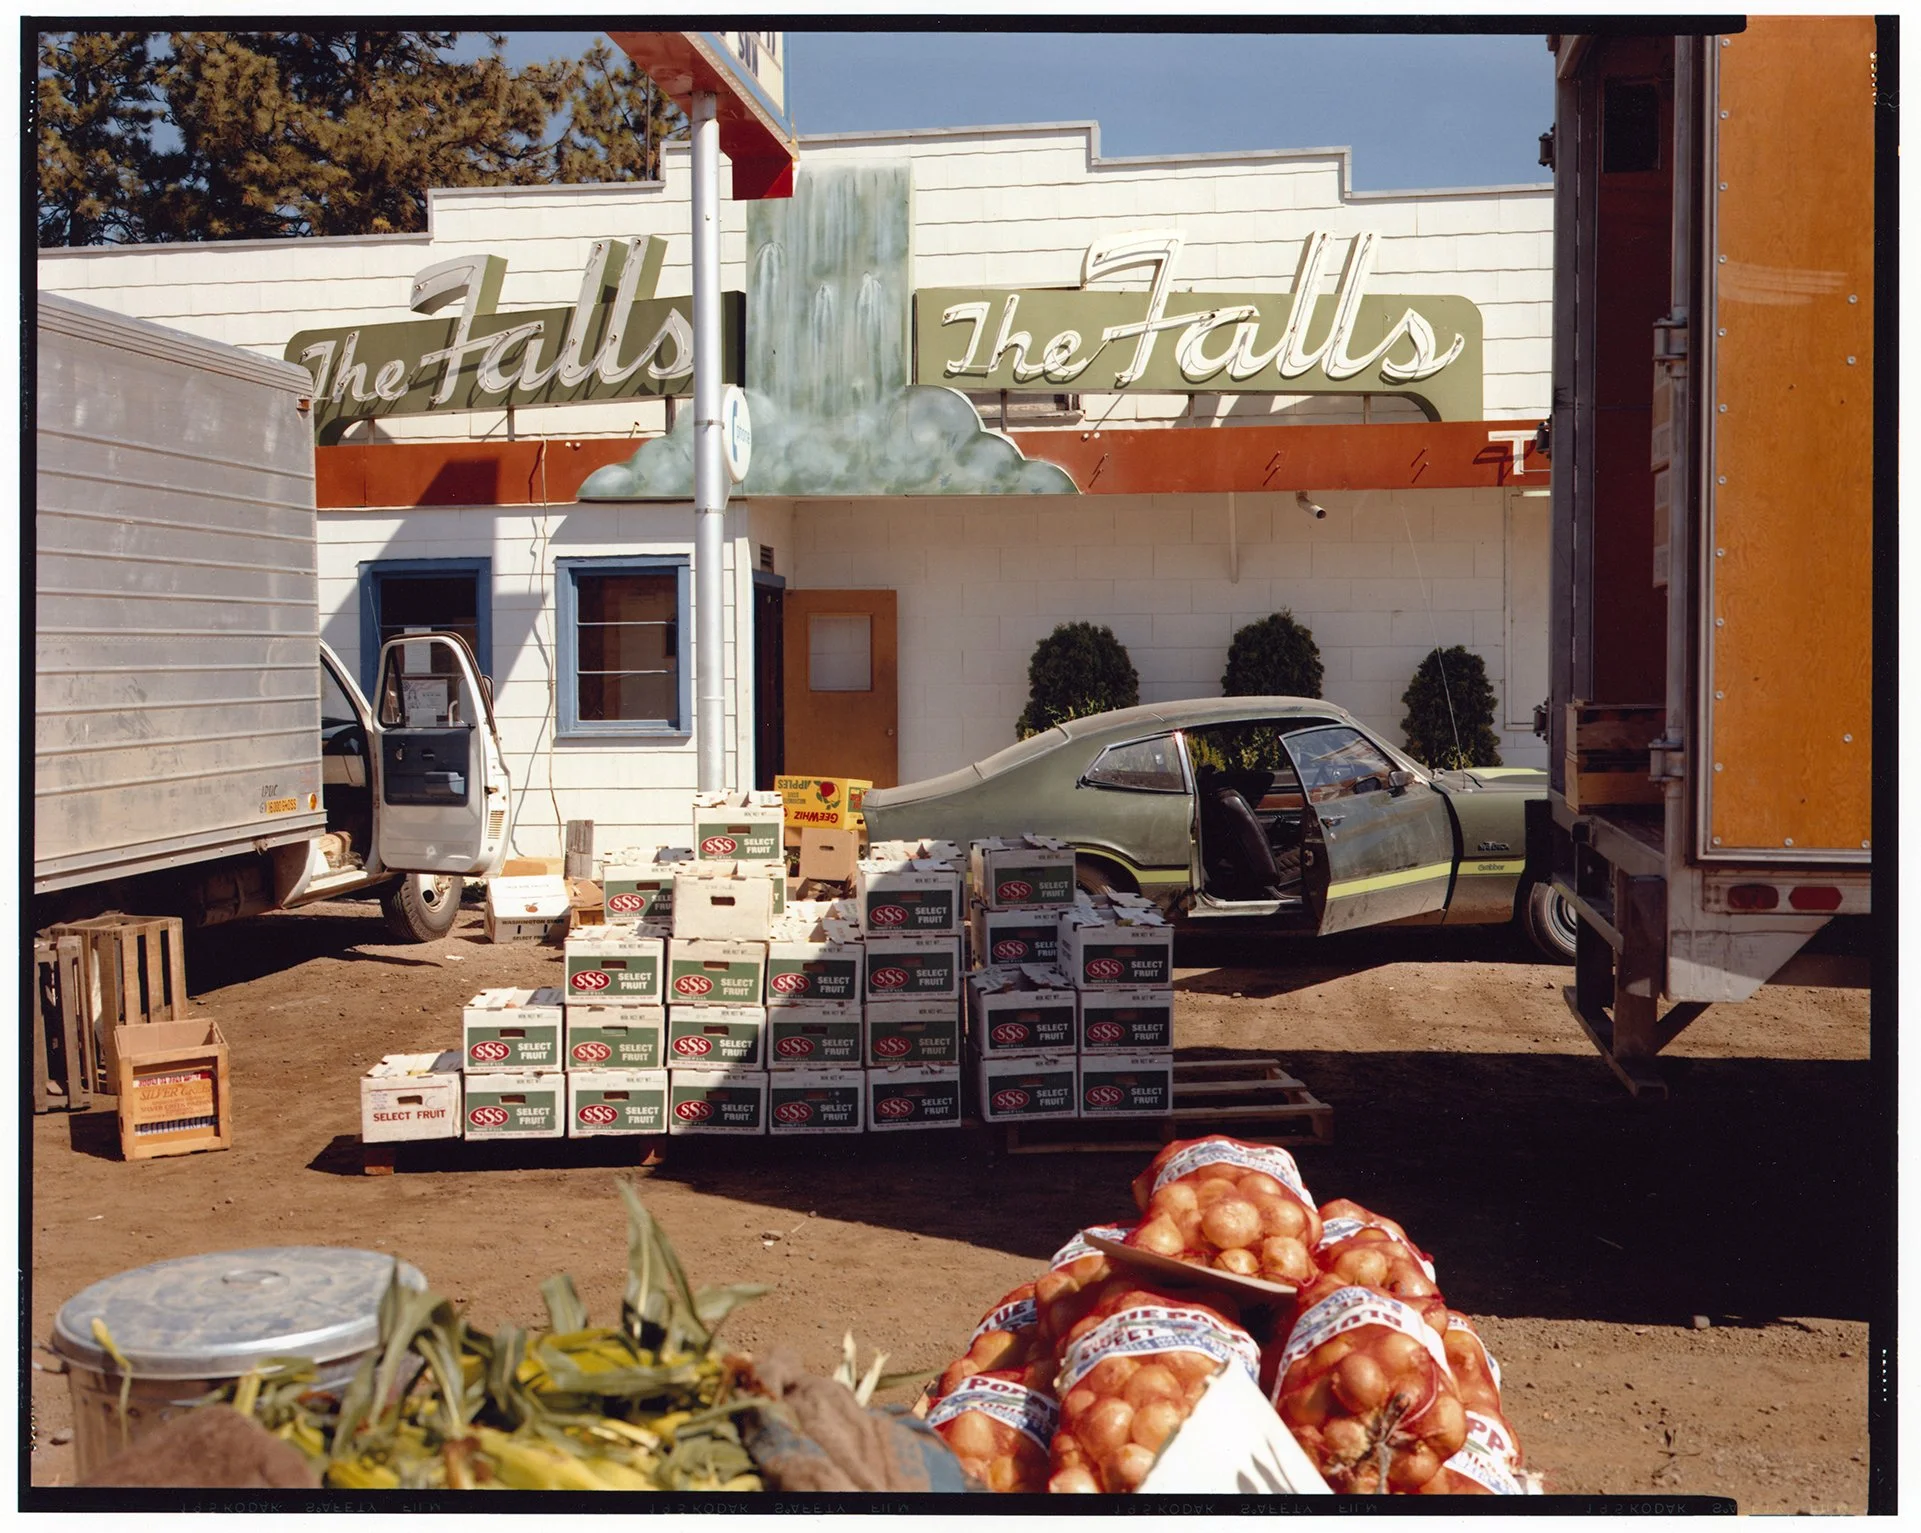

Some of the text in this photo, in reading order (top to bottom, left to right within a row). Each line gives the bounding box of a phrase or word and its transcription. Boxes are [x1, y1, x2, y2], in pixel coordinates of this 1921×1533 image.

[942, 228, 1464, 383] The Falls
[301, 235, 694, 405] The Falls
[1487, 429, 1539, 475] T
[778, 779, 811, 790] APPLES
[705, 836, 732, 855] SSS
[744, 838, 775, 846] SELECT
[746, 846, 771, 854] FRUIT
[1002, 882, 1028, 897] SSS
[1039, 881, 1069, 889] SELECT
[613, 895, 641, 910] SSS
[651, 894, 672, 902] SELE
[655, 902, 672, 910] FRU
[915, 906, 947, 915] SELECT
[876, 907, 903, 925] SSS
[918, 915, 943, 924] FRUIT
[998, 942, 1024, 956] SSS
[1035, 941, 1057, 949] SELE
[1037, 949, 1057, 957] FRUI
[1092, 960, 1119, 975] SSS
[1131, 960, 1163, 968] SELECT
[618, 973, 652, 981] SELECT
[876, 969, 904, 985] SSS
[916, 969, 948, 977] SELECT
[1134, 969, 1159, 977] FRUIT
[576, 972, 605, 988] SSS
[679, 975, 708, 991] SSS
[720, 978, 754, 987] SELECT
[777, 974, 805, 990] SSS
[817, 976, 850, 985] SELECT
[919, 977, 944, 986] FRUIT
[621, 982, 648, 990] FRUIT
[820, 985, 846, 993] FRUIT
[723, 987, 750, 996] FRUIT
[1036, 1023, 1068, 1032] SELECT
[1093, 1024, 1119, 1039] SSS
[1132, 1023, 1164, 1032] SELECT
[997, 1025, 1024, 1041] SSS
[1040, 1032, 1065, 1041] FRUIT
[1134, 1032, 1160, 1041] FRUIT
[517, 1042, 552, 1051] SELECT
[678, 1036, 707, 1053] SSS
[719, 1039, 753, 1048] SELECT
[782, 1038, 809, 1054] SSS
[822, 1038, 855, 1047] SELECT
[880, 1037, 906, 1052] SSS
[919, 1038, 950, 1046] SELECT
[476, 1042, 505, 1059] SSS
[577, 1043, 606, 1059] SSS
[619, 1043, 653, 1052] SELECT
[825, 1047, 850, 1056] FRUIT
[921, 1047, 947, 1055] FRUIT
[520, 1051, 548, 1060] FRUIT
[622, 1052, 649, 1061] FRUIT
[722, 1048, 748, 1057] FRUIT
[1036, 1088, 1069, 1098] SELECT
[1092, 1087, 1118, 1102] SSS
[1131, 1087, 1163, 1096] SELECT
[921, 1097, 953, 1106] SELECT
[997, 1091, 1024, 1106] SSS
[1040, 1097, 1065, 1107] FRUIT
[1134, 1096, 1159, 1104] FRUIT
[625, 1106, 660, 1115] SELECT
[680, 1100, 709, 1117] SSS
[721, 1104, 755, 1112] SELECT
[820, 1103, 853, 1112] SELECT
[882, 1099, 908, 1115] SSS
[924, 1106, 949, 1115] FRUIT
[373, 1109, 446, 1122] SELECT FRUIT
[475, 1107, 504, 1124] SSS
[516, 1108, 550, 1117] SELECT
[584, 1105, 613, 1121] SSS
[780, 1104, 808, 1120] SSS
[823, 1112, 849, 1120] FRUIT
[519, 1117, 546, 1125] FRUIT
[628, 1115, 655, 1124] FRUIT
[723, 1113, 750, 1121] FRUIT
